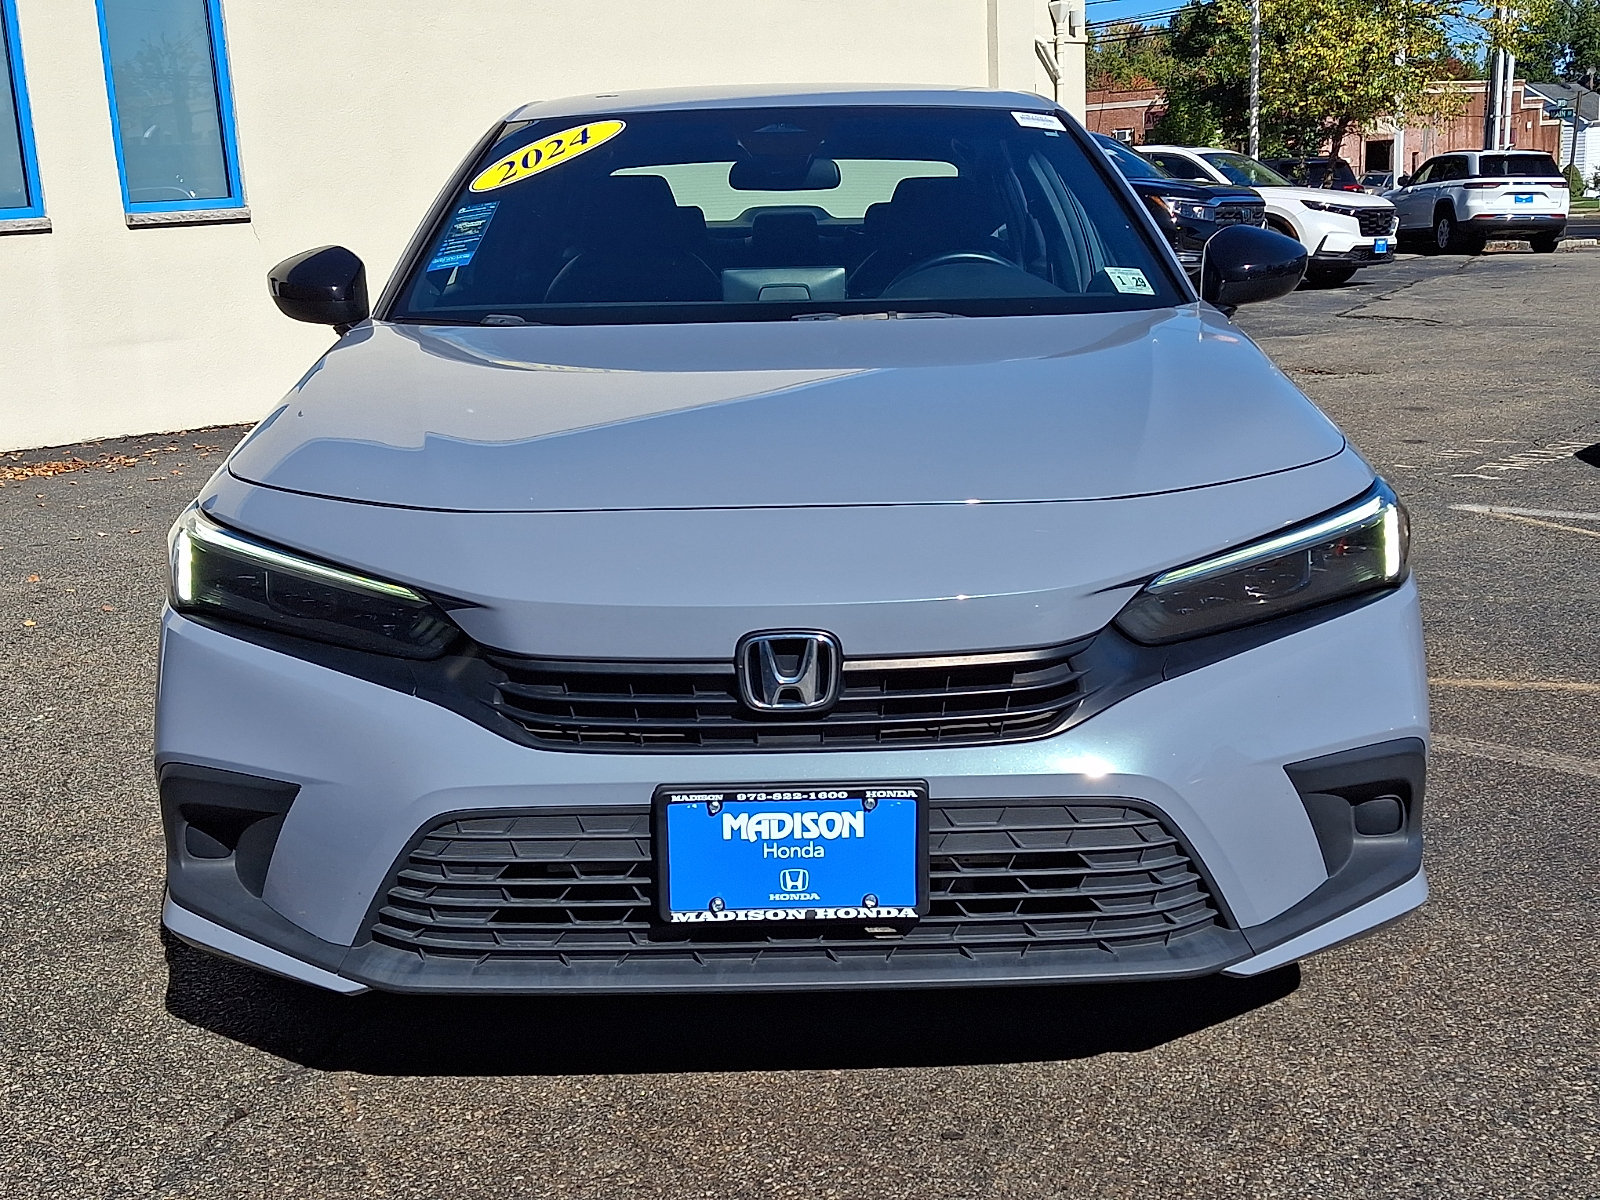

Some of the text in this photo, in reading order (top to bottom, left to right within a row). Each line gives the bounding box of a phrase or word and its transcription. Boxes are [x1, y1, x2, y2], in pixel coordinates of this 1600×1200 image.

[497, 127, 591, 184] 2024
[1117, 275, 1147, 288] 1 29
[671, 790, 919, 802] MADISON 973-822-1600 HONDA
[722, 811, 864, 842] MADISON
[763, 841, 825, 859] Honda
[769, 892, 820, 901] HONDA
[670, 907, 919, 922] MADISON HONDA
